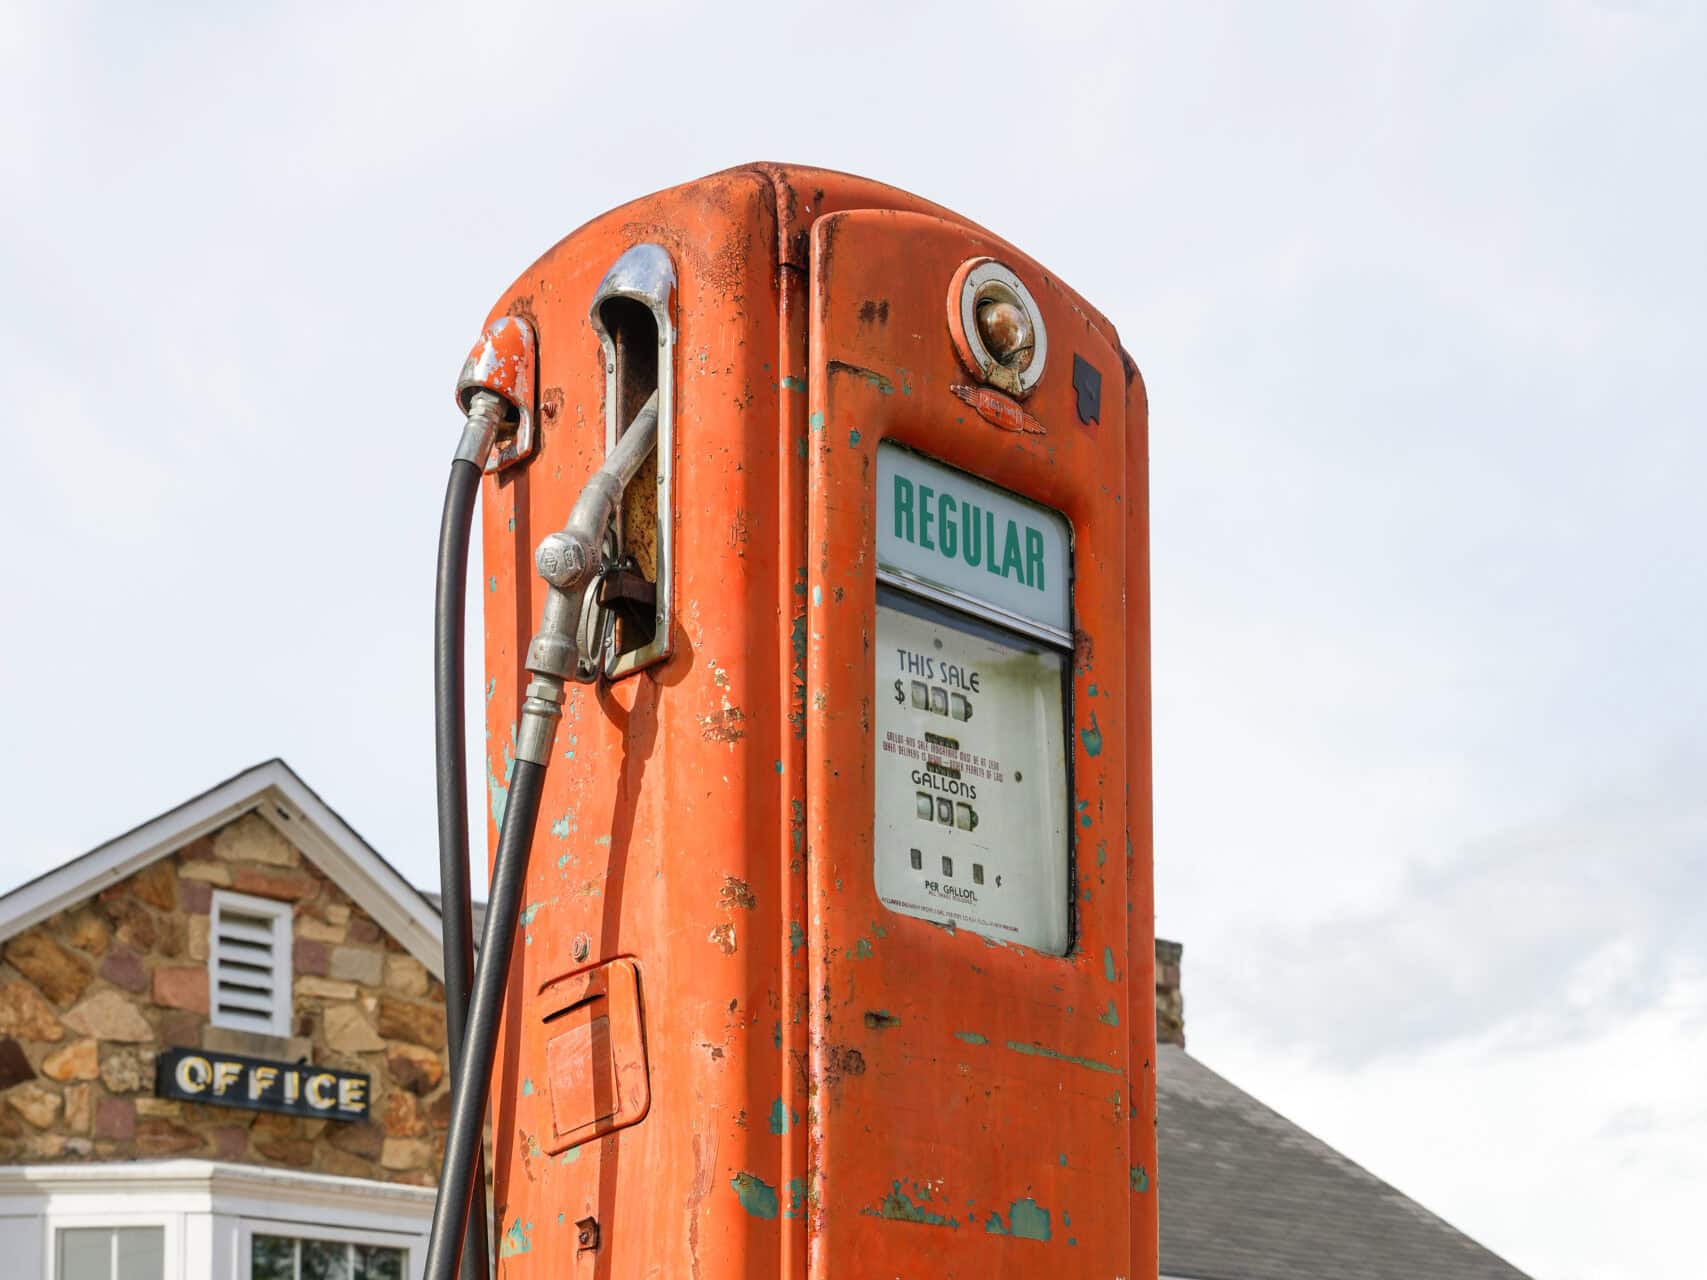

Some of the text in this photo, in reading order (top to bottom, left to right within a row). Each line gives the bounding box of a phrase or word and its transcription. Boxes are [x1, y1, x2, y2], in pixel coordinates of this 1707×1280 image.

[895, 474, 1044, 592] REGULAR
[897, 648, 980, 693] THIS SALE
[894, 679, 906, 704] $
[911, 769, 977, 800] GALLONS
[925, 880, 940, 892] PER
[175, 1056, 367, 1112] OFFICE
